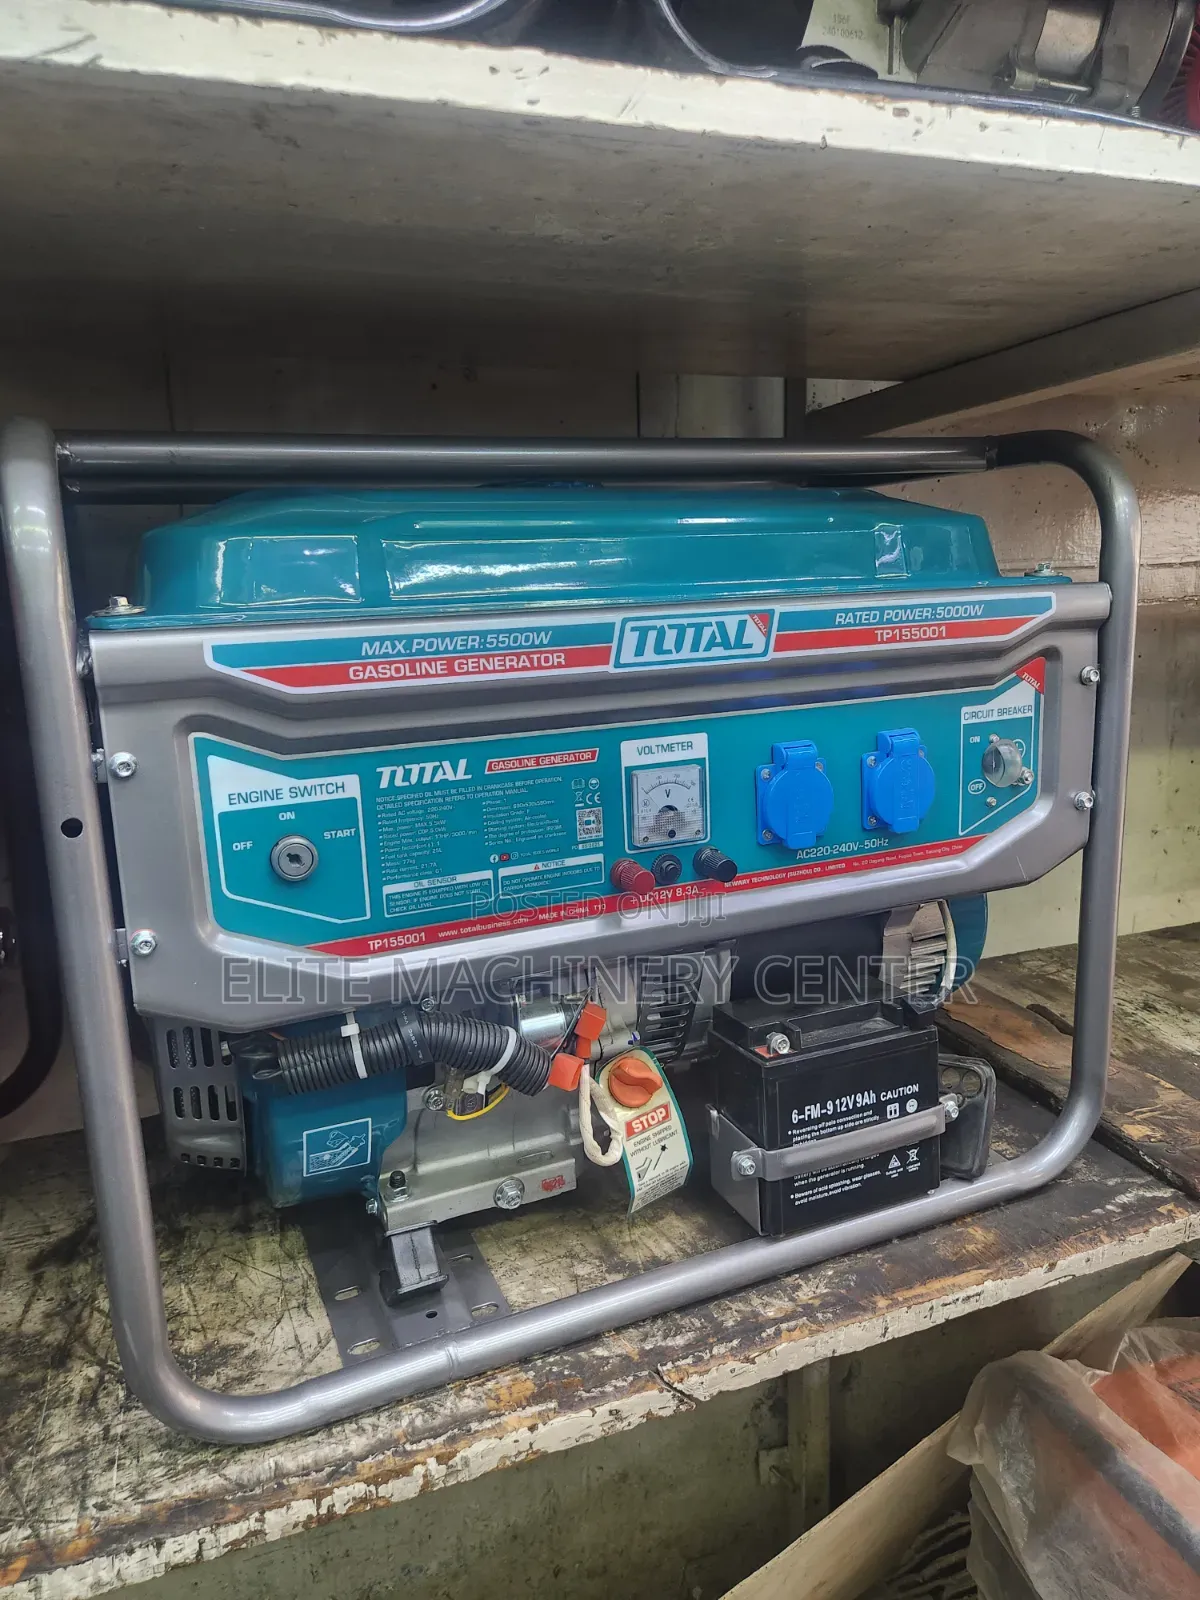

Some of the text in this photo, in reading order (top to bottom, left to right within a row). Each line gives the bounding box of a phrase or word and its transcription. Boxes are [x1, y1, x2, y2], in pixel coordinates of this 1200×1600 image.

[752, 615, 767, 633] TOTAL
[835, 611, 879, 625] RATED
[630, 619, 754, 656] TOTAL
[875, 626, 946, 642] TP155001
[348, 653, 564, 681] GASOLINE GENERATOR
[1022, 672, 1041, 689] TOTAL
[963, 705, 1032, 720] CIRCUIT BREAKER
[637, 741, 693, 756] VOLTMETER
[491, 752, 592, 770] GASOLINE GENERATOR
[376, 758, 472, 789] TOTAL
[484, 781, 514, 790] CRANKCASE
[515, 779, 533, 787] BEFORE
[228, 782, 345, 805] ENGINE SWITCH
[377, 802, 403, 810] DETAILED
[404, 797, 443, 807] SPECIFICATION
[475, 791, 503, 799] OPERATION
[586, 792, 600, 805] CE
[665, 788, 670, 798] V
[278, 811, 295, 820] ON
[324, 828, 356, 839] START
[232, 841, 253, 851] OFF
[542, 860, 566, 869] NOTICE
[427, 876, 457, 886] SENSOR
[521, 875, 543, 883] OPERATE
[751, 873, 786, 884] TECHNOLOGY
[825, 863, 845, 871] LIMITED
[402, 891, 422, 899] ENGINE
[429, 886, 453, 894] EQUIPPED
[676, 886, 699, 896] 8.3A
[368, 932, 425, 950] TP155001
[438, 918, 529, 938] www.totalbusiness.com
[539, 911, 558, 920] MADE
[569, 907, 589, 915] CHINA
[835, 1094, 854, 1112] 12V
[856, 1090, 876, 1107] 9Ah
[880, 1083, 919, 1101] CAUTION
[632, 1107, 667, 1132] STOP
[793, 1124, 818, 1135] Reversing
[825, 1120, 836, 1128] pole
[793, 1133, 811, 1143] placing
[820, 1126, 837, 1134] bottom
[864, 1114, 880, 1124] strictly
[633, 1125, 672, 1147] ENGINE SHIPPED
[630, 1143, 651, 1157] WITHOUT
[794, 1179, 808, 1187] when
[817, 1170, 840, 1182] generator
[794, 1198, 808, 1206] avoid
[795, 1190, 812, 1199] Beware
